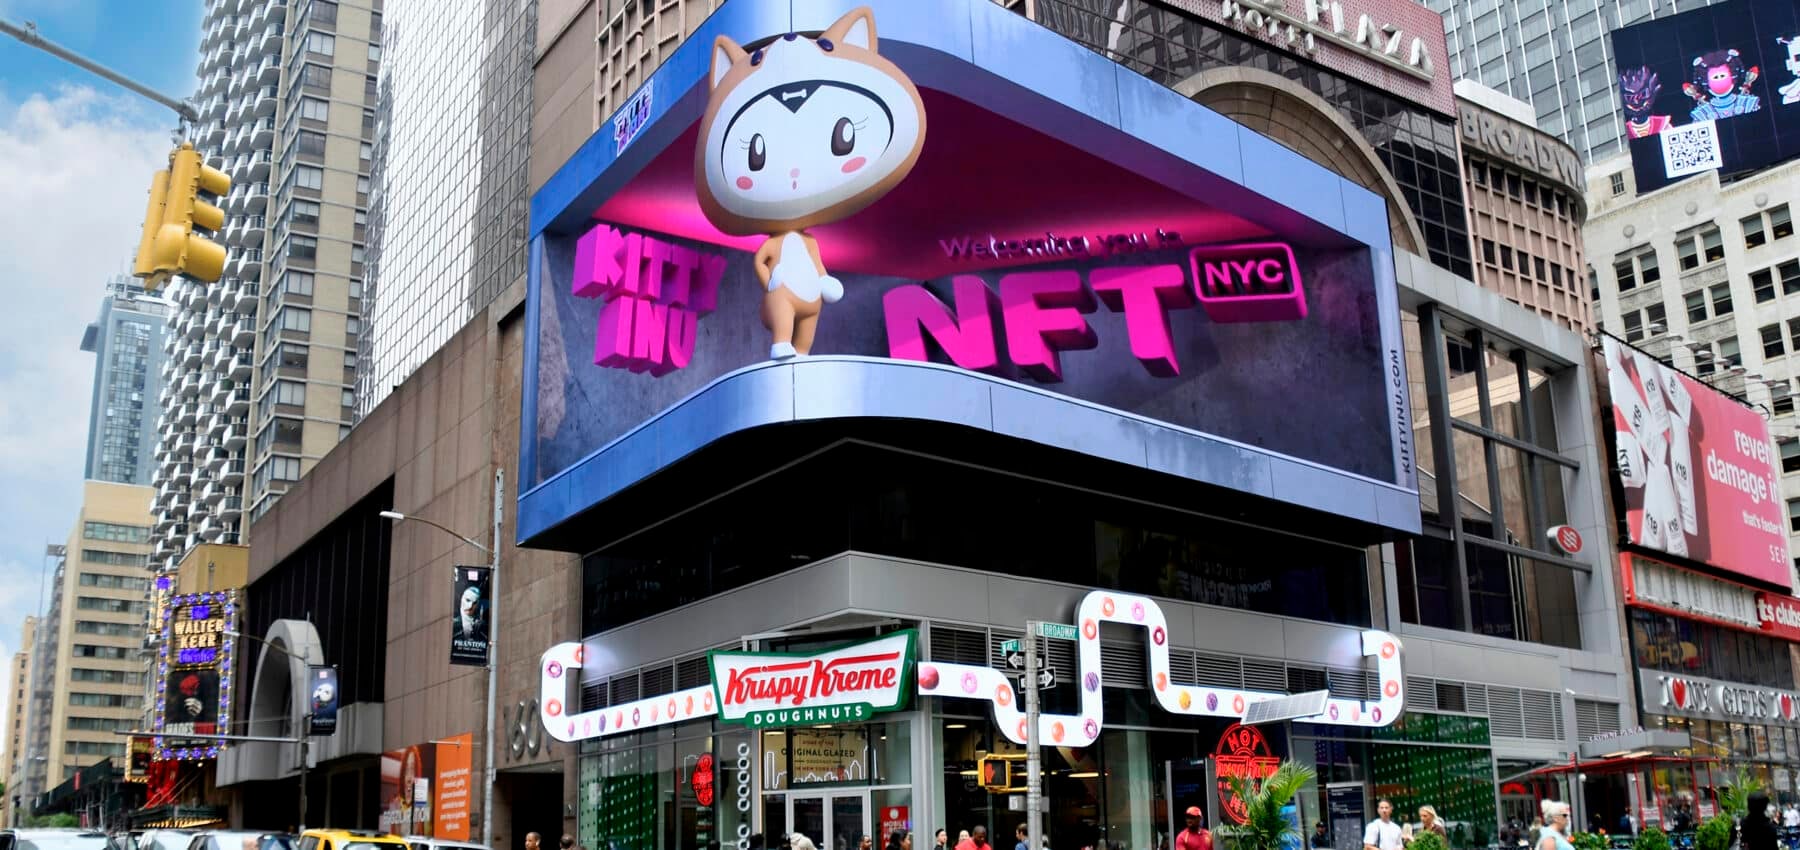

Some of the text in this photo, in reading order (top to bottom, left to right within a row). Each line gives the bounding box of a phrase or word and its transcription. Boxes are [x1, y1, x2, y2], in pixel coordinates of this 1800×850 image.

[938, 231, 1091, 260] Welcoming
[1096, 232, 1149, 259] you
[573, 223, 728, 313] KITTY
[1204, 258, 1284, 287] NYC
[594, 295, 698, 377] INU
[883, 264, 1193, 381] NFT
[1389, 349, 1411, 474] KITTYINU.COM
[1707, 449, 1767, 504] damage
[174, 618, 224, 635] WALTER
[1044, 624, 1076, 639] BROADWAY
[180, 634, 217, 649] KERR
[724, 652, 900, 705] Krispy Kreme
[753, 706, 863, 725] DOUGHNUTS
[1717, 686, 1769, 719] GIFTS
[781, 748, 855, 758] OIGINAL GLAZED
[1227, 730, 1261, 752] HOT
